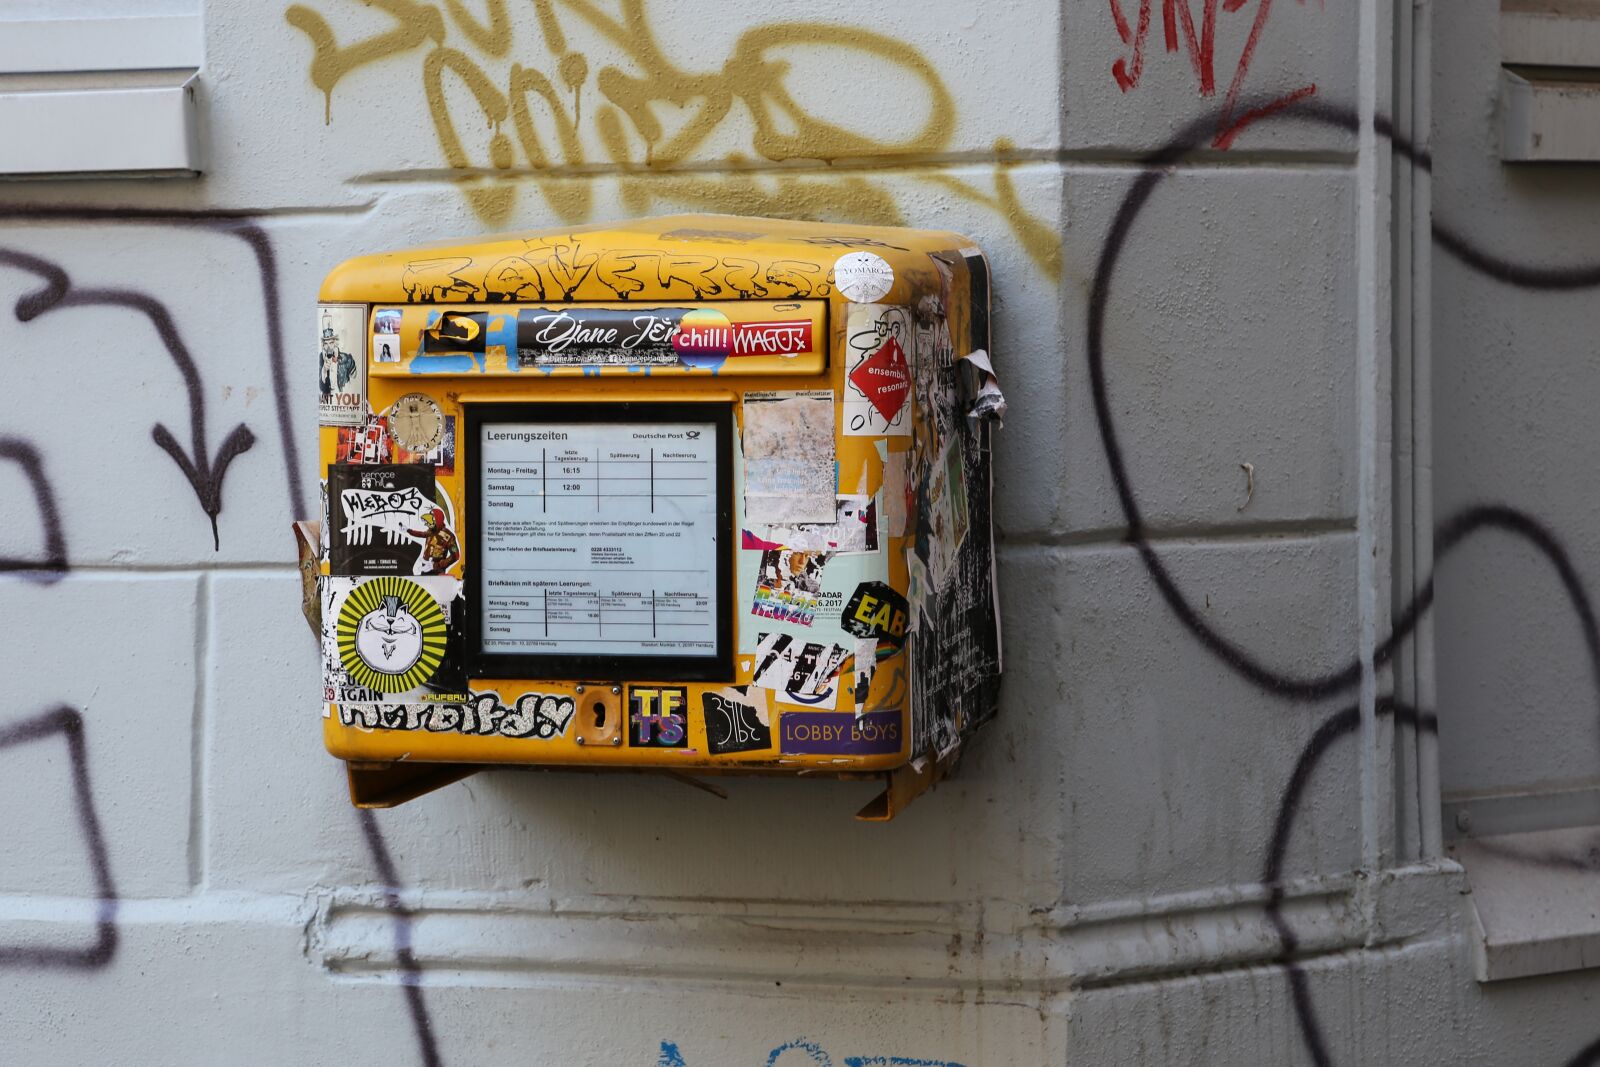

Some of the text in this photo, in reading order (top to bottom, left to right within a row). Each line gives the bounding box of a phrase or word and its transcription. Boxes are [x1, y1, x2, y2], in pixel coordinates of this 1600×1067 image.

[680, 328, 727, 348] chill!
[335, 393, 361, 406] YOU
[487, 431, 568, 441] Leerungszeiten
[487, 484, 515, 492] Samstag
[559, 580, 592, 588] Leerungen:
[855, 594, 906, 637] EAB
[338, 688, 384, 702] AGAIN
[786, 724, 897, 741] LOBBY BOYS
